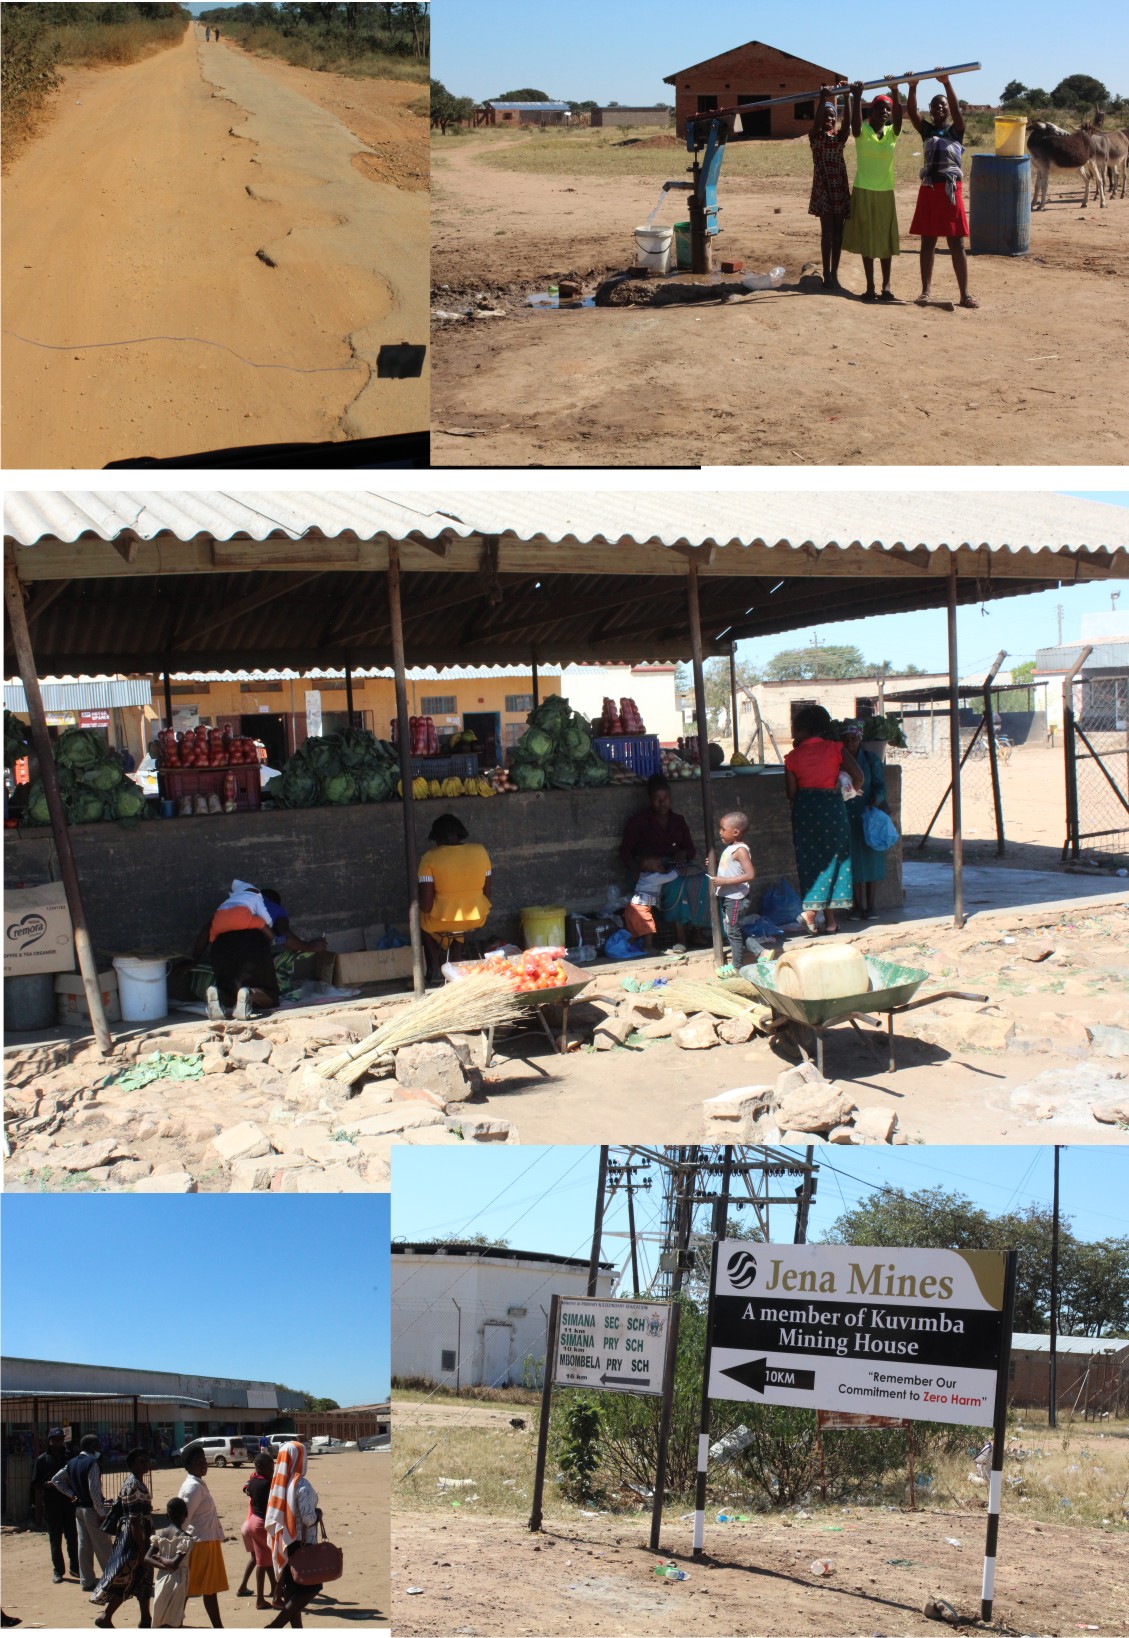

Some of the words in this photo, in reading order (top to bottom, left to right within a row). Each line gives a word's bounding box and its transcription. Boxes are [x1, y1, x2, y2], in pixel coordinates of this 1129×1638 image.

[766, 1260, 837, 1293] Jena
[846, 1263, 953, 1299] Mines
[562, 1312, 595, 1328] SIMANA
[604, 1316, 619, 1330] SEC
[627, 1318, 645, 1331] SCH
[741, 1302, 755, 1320] A
[760, 1305, 841, 1326] member
[844, 1308, 867, 1327] of
[560, 1333, 594, 1348] SIMANA
[604, 1337, 619, 1350] PRY
[625, 1339, 643, 1352] SCH
[778, 1328, 849, 1355] Mining
[854, 1333, 919, 1355] House
[560, 1354, 600, 1369] MBOMBELA
[606, 1358, 622, 1371] PRY
[631, 1360, 649, 1372] SCH
[765, 1370, 795, 1384] 10KM
[936, 1377, 957, 1388] Our
[838, 1384, 906, 1399] Commitment
[910, 1390, 920, 1400] to
[923, 1392, 947, 1403] Zero
[951, 1394, 987, 1407] Harm"
